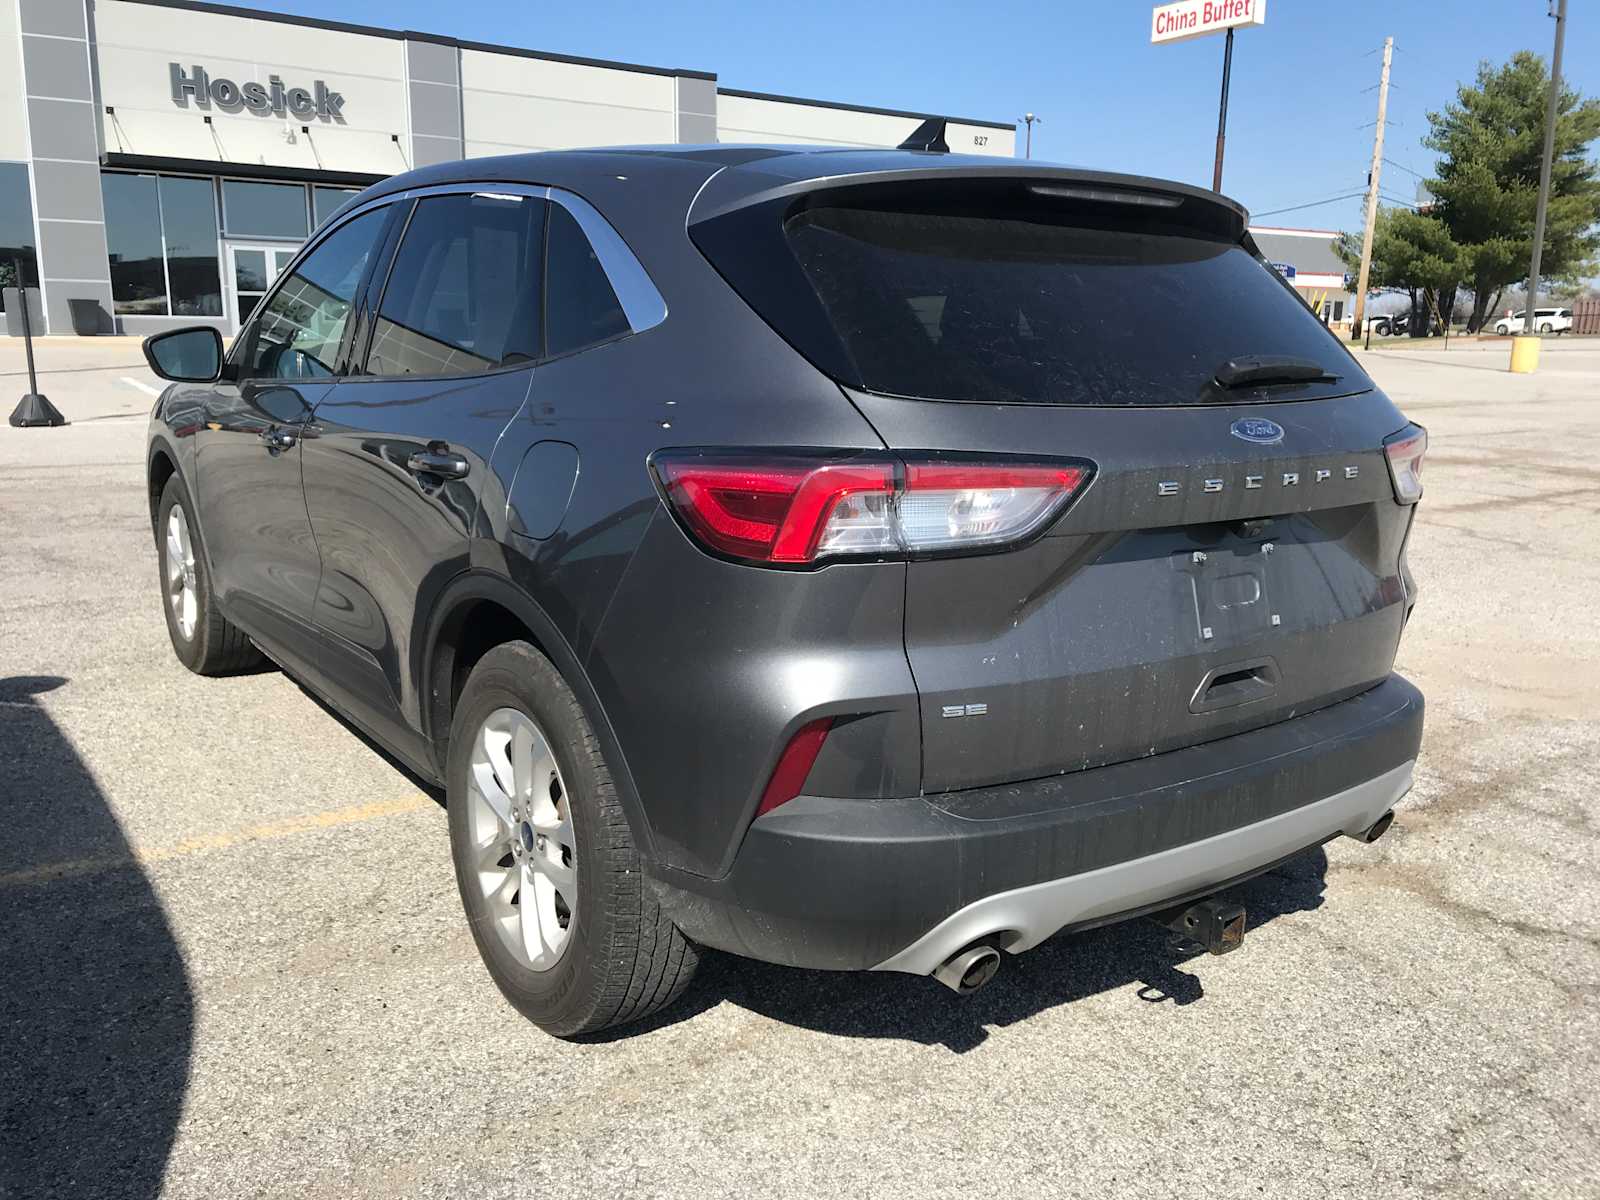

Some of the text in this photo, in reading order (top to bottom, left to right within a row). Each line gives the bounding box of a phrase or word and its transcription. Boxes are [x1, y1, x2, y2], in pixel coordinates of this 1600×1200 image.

[1156, 0, 1250, 35] China Buffet
[168, 62, 346, 119] Hosick
[974, 136, 989, 146] 827
[1245, 421, 1274, 435] Ford
[1157, 465, 1360, 496] ESCAPE
[941, 703, 988, 718] SE
